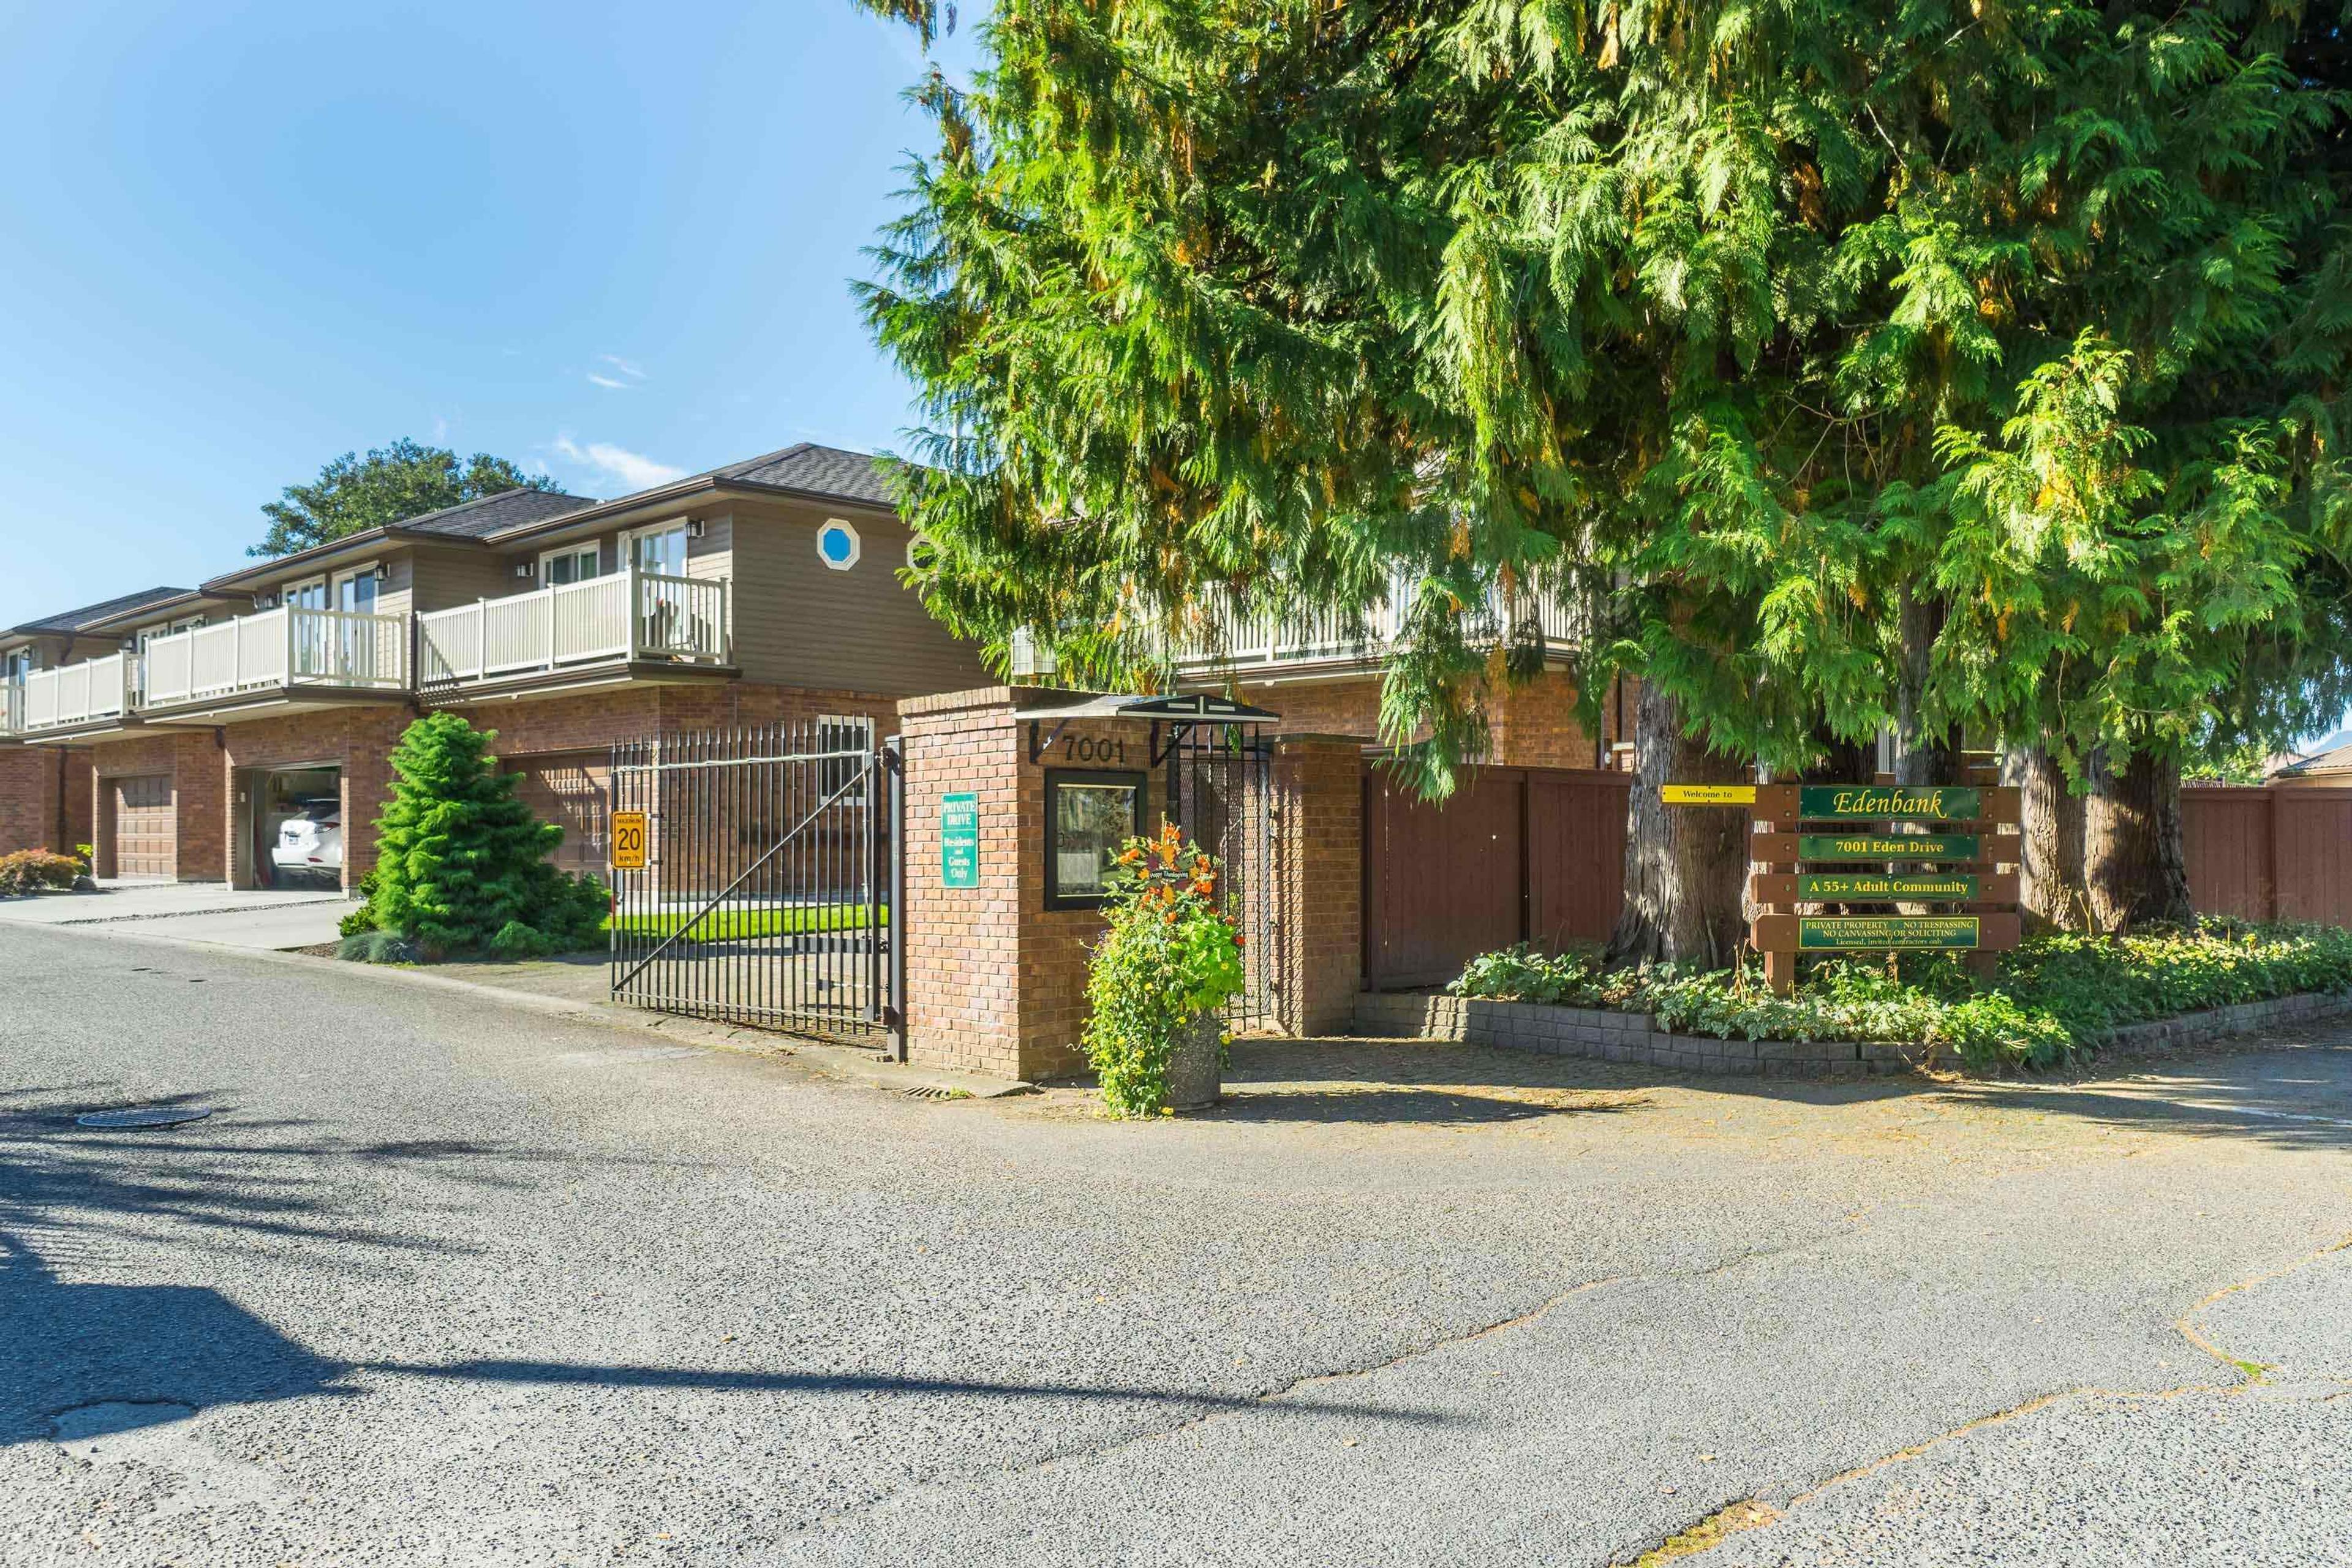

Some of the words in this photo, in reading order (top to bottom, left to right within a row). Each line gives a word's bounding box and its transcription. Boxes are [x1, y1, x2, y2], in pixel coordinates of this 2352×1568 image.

[1063, 735, 1124, 763] 7001
[943, 801, 975, 813] PRIVATE
[1833, 790, 1948, 819] Edenbank
[948, 814, 971, 826] DRIVE
[618, 827, 641, 850] 20
[944, 836, 974, 846] Residents
[1836, 842, 1867, 853] 7001
[1872, 842, 1905, 853] Eden
[1910, 841, 1944, 853] Drive
[948, 857, 970, 867] Guests
[950, 868, 968, 880] Only
[1810, 882, 1819, 892] A
[1823, 882, 1849, 892] 55+
[1853, 881, 1889, 892] Adult
[1893, 881, 1968, 894] Community
